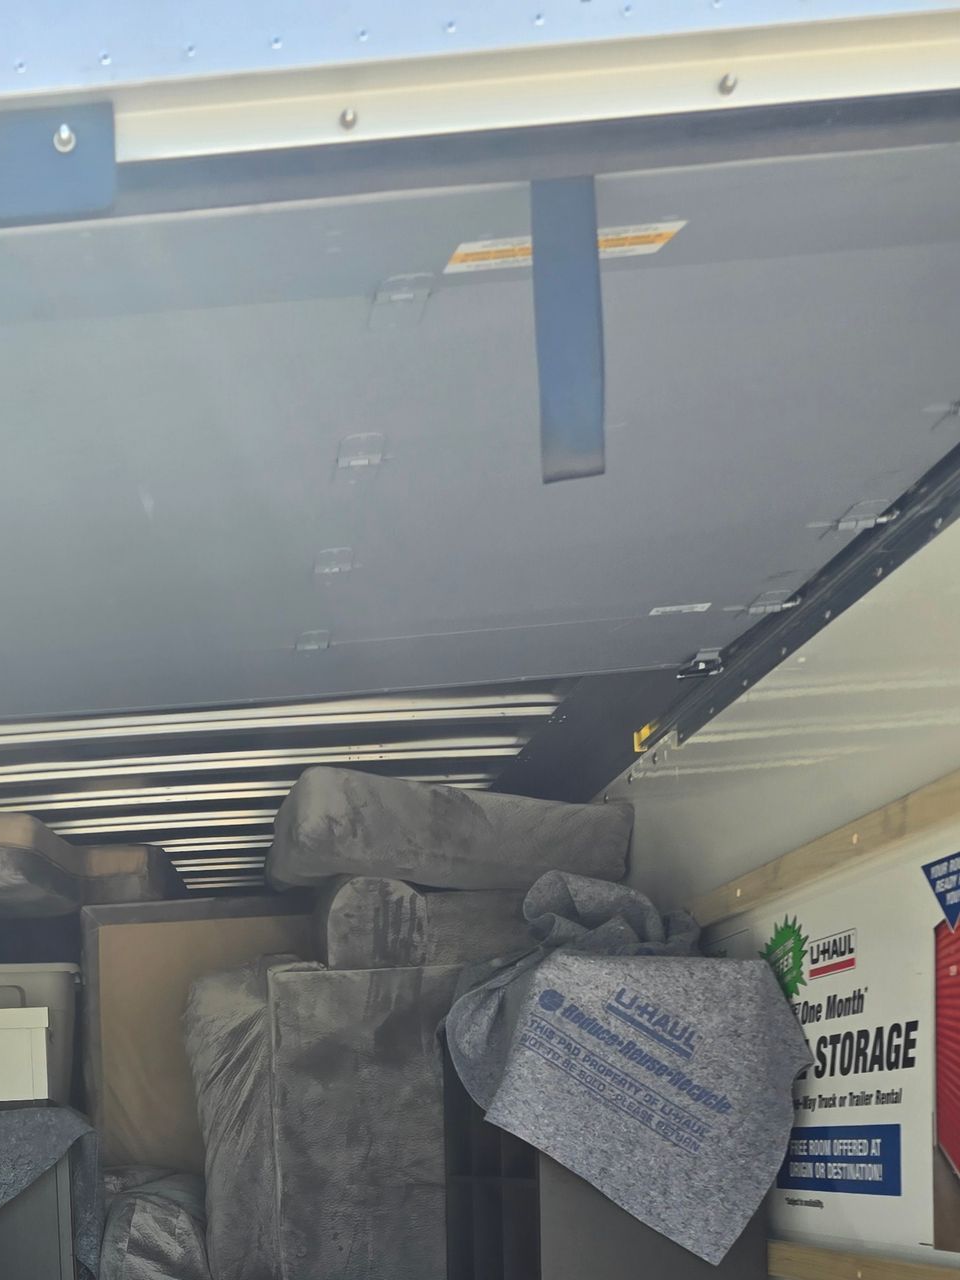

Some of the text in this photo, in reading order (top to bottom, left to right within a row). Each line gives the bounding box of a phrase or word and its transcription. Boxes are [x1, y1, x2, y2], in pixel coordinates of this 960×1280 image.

[801, 999, 823, 1026] One
[813, 1019, 920, 1080] STORAGE
[557, 1034, 580, 1057] PAD
[582, 1053, 641, 1096] PROPERTY
[644, 1093, 659, 1109] OF
[547, 1047, 562, 1063] TO
[562, 1057, 578, 1073] BE
[578, 1065, 608, 1092] SOLD
[616, 1092, 654, 1127] PLEASE
[656, 1118, 702, 1152] RETURN
[818, 1093, 838, 1109] Truck
[838, 1095, 848, 1108] or
[848, 1090, 874, 1107] Trailer
[875, 1087, 903, 1105] Rental
[789, 1138, 882, 1157] FREE ROOM OFFERED AT
[789, 1161, 883, 1181] ORIGIN OR DESTINATION!
